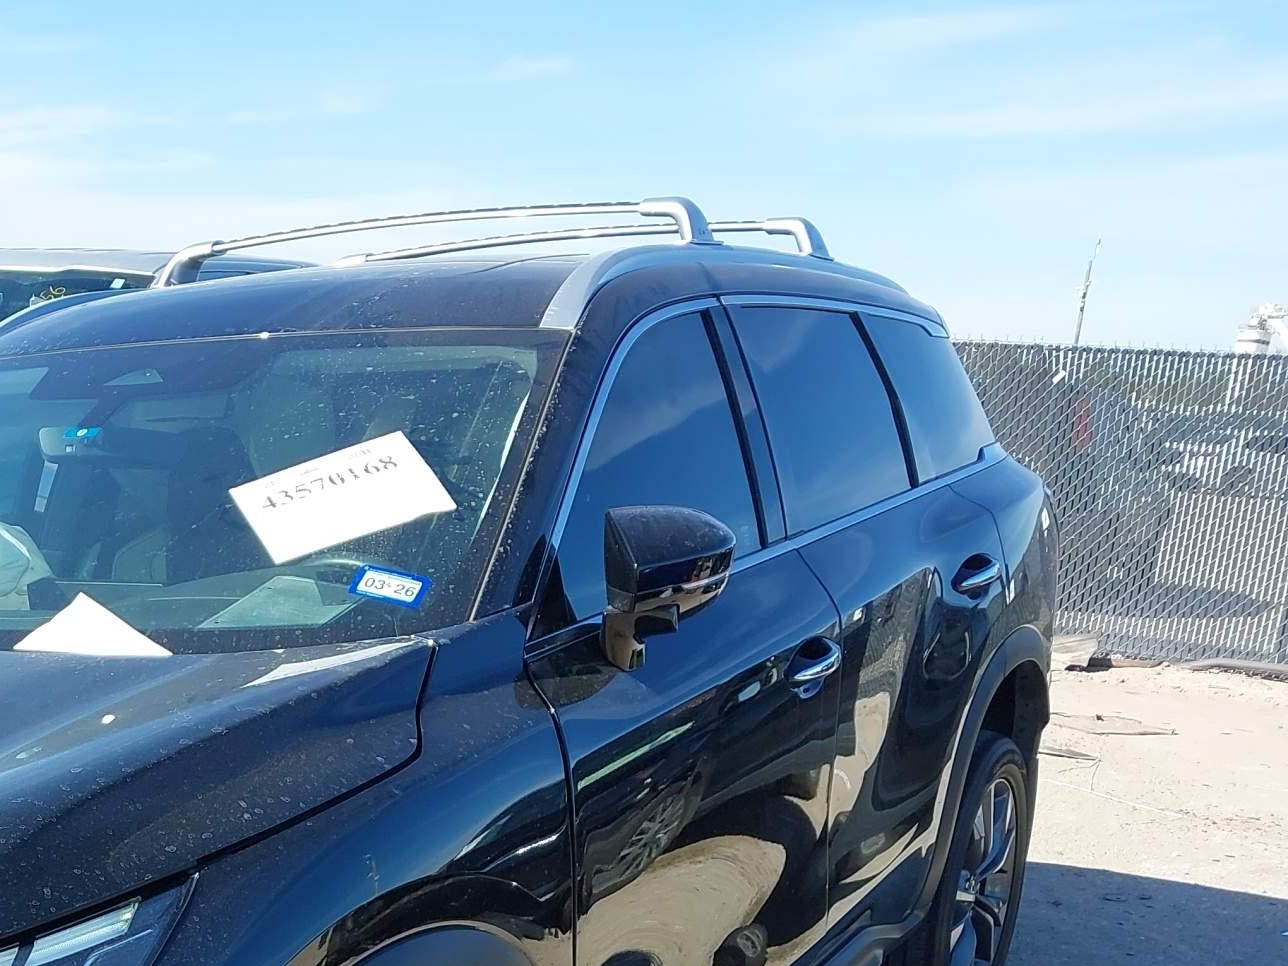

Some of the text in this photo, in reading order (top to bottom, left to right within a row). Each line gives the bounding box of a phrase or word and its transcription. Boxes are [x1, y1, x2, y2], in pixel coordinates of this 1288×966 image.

[262, 456, 398, 509] 43570168
[364, 577, 417, 598] 03 26
